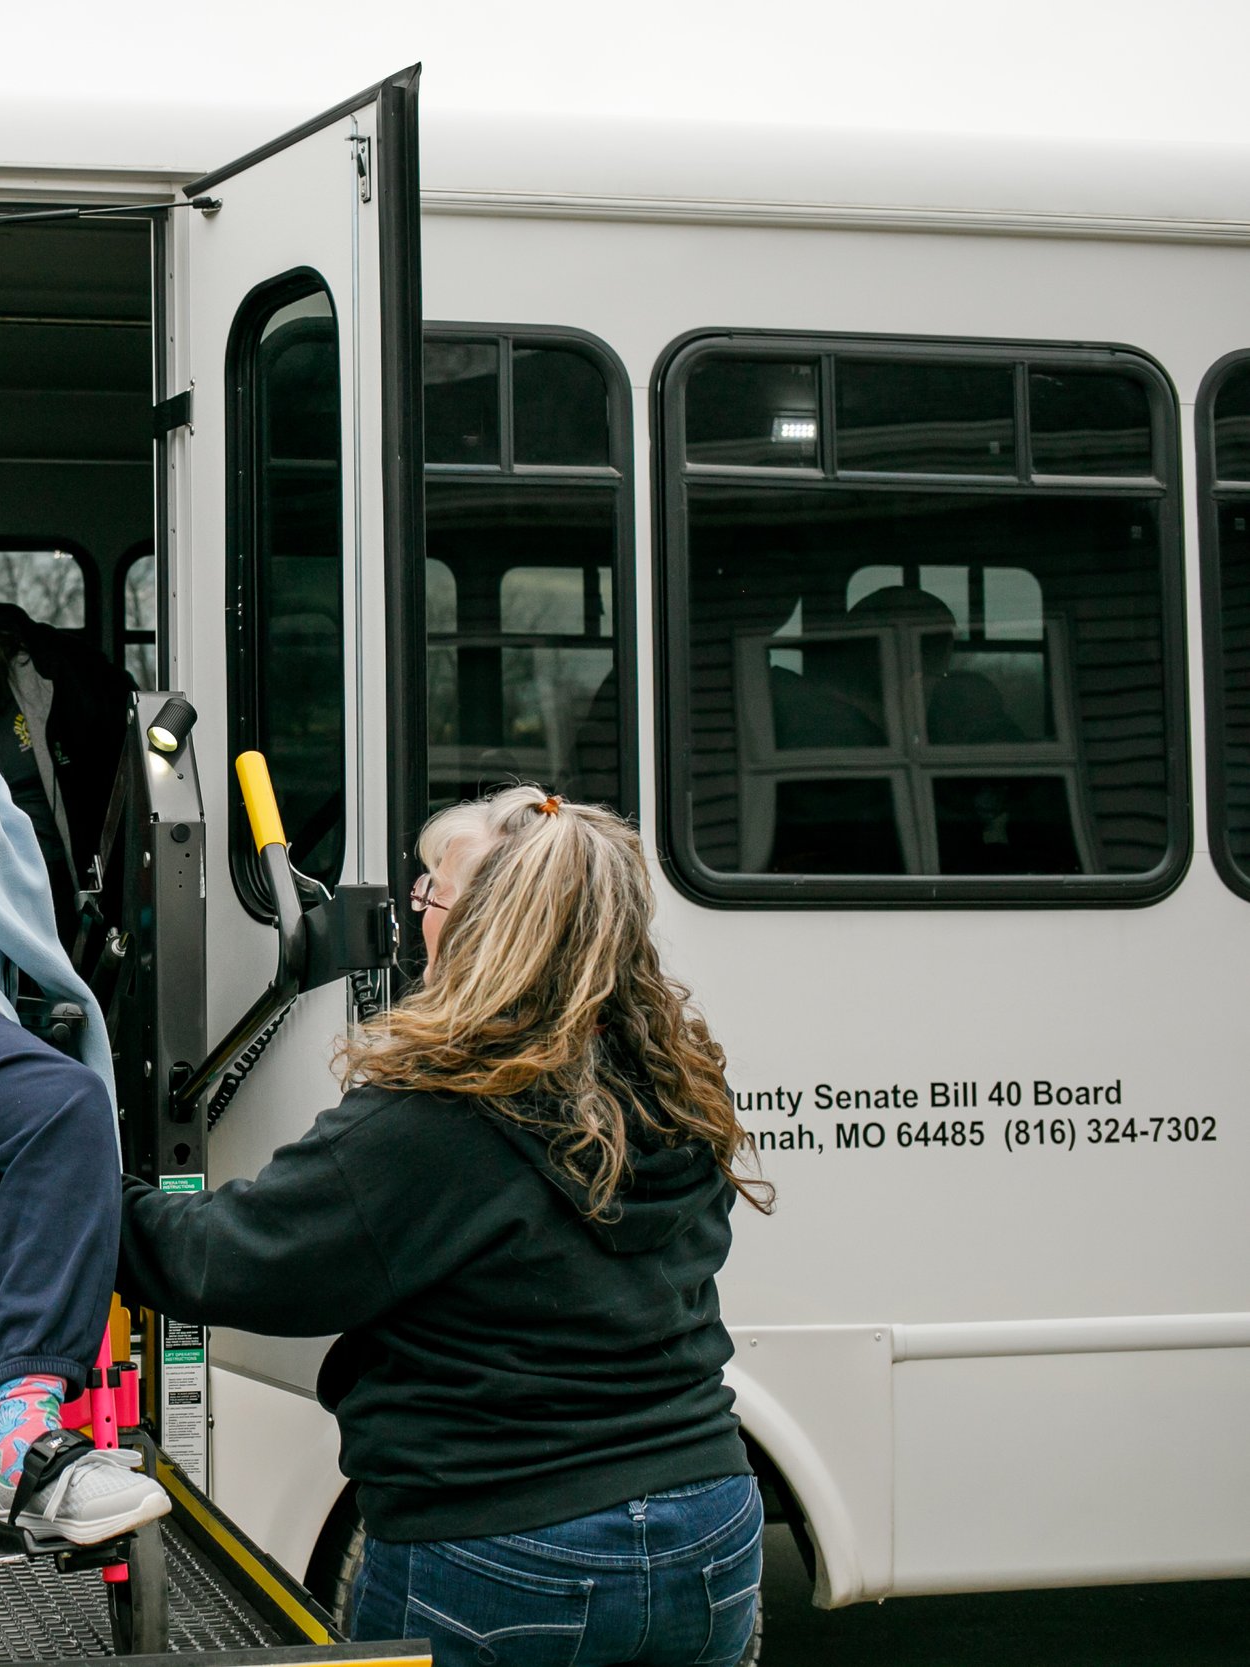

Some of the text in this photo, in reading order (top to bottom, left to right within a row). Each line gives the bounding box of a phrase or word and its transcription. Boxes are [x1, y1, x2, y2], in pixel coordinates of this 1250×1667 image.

[814, 1083, 919, 1110] Senate
[930, 1081, 977, 1108] Bill
[988, 1081, 1022, 1107] 40
[1033, 1079, 1122, 1106] Board
[836, 1122, 886, 1149] MO
[896, 1120, 985, 1148] 64485
[1004, 1118, 1076, 1153] (816)
[1087, 1115, 1217, 1145] 324-7302
